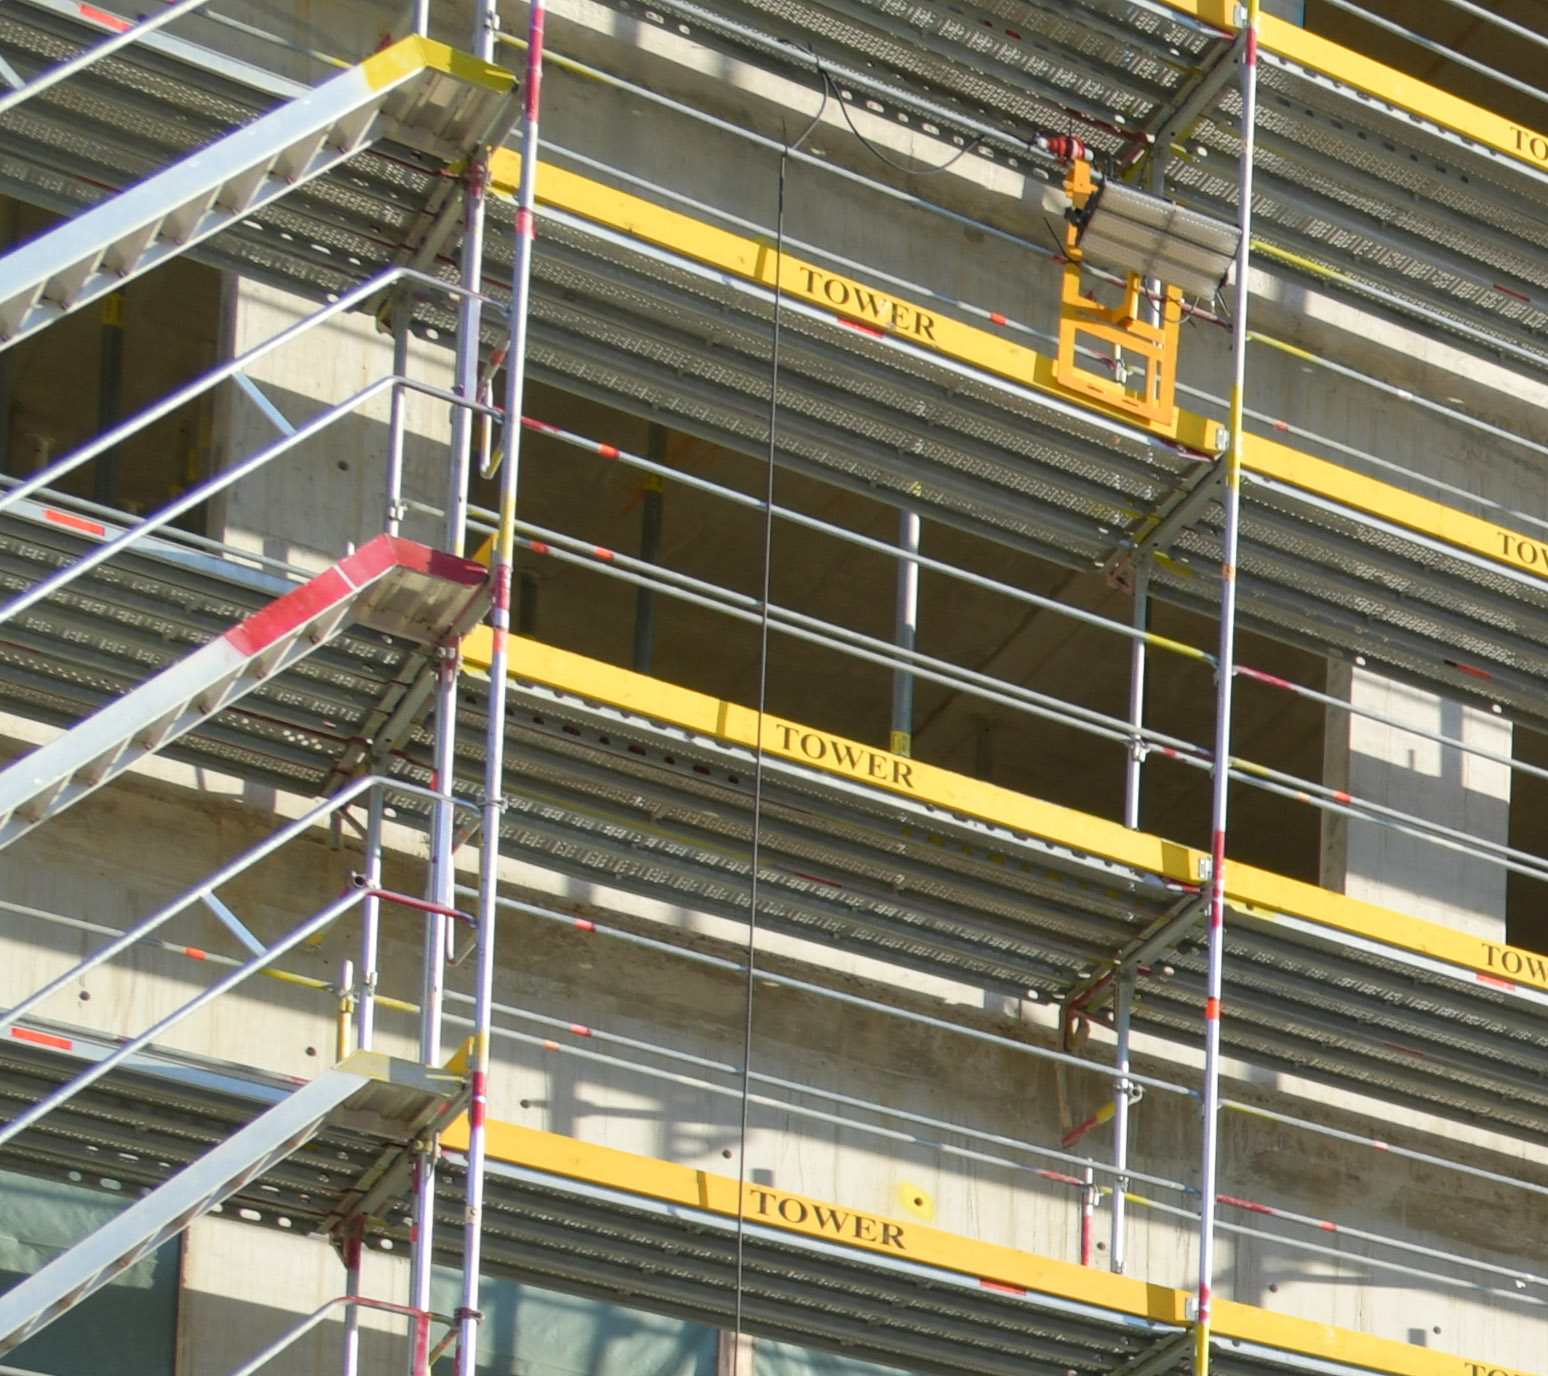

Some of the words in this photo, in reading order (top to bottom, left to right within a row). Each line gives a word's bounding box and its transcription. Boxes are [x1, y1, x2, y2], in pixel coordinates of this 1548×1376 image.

[799, 266, 936, 342] TOWER
[775, 721, 917, 789] TOWER
[748, 1186, 907, 1250] TOWER
